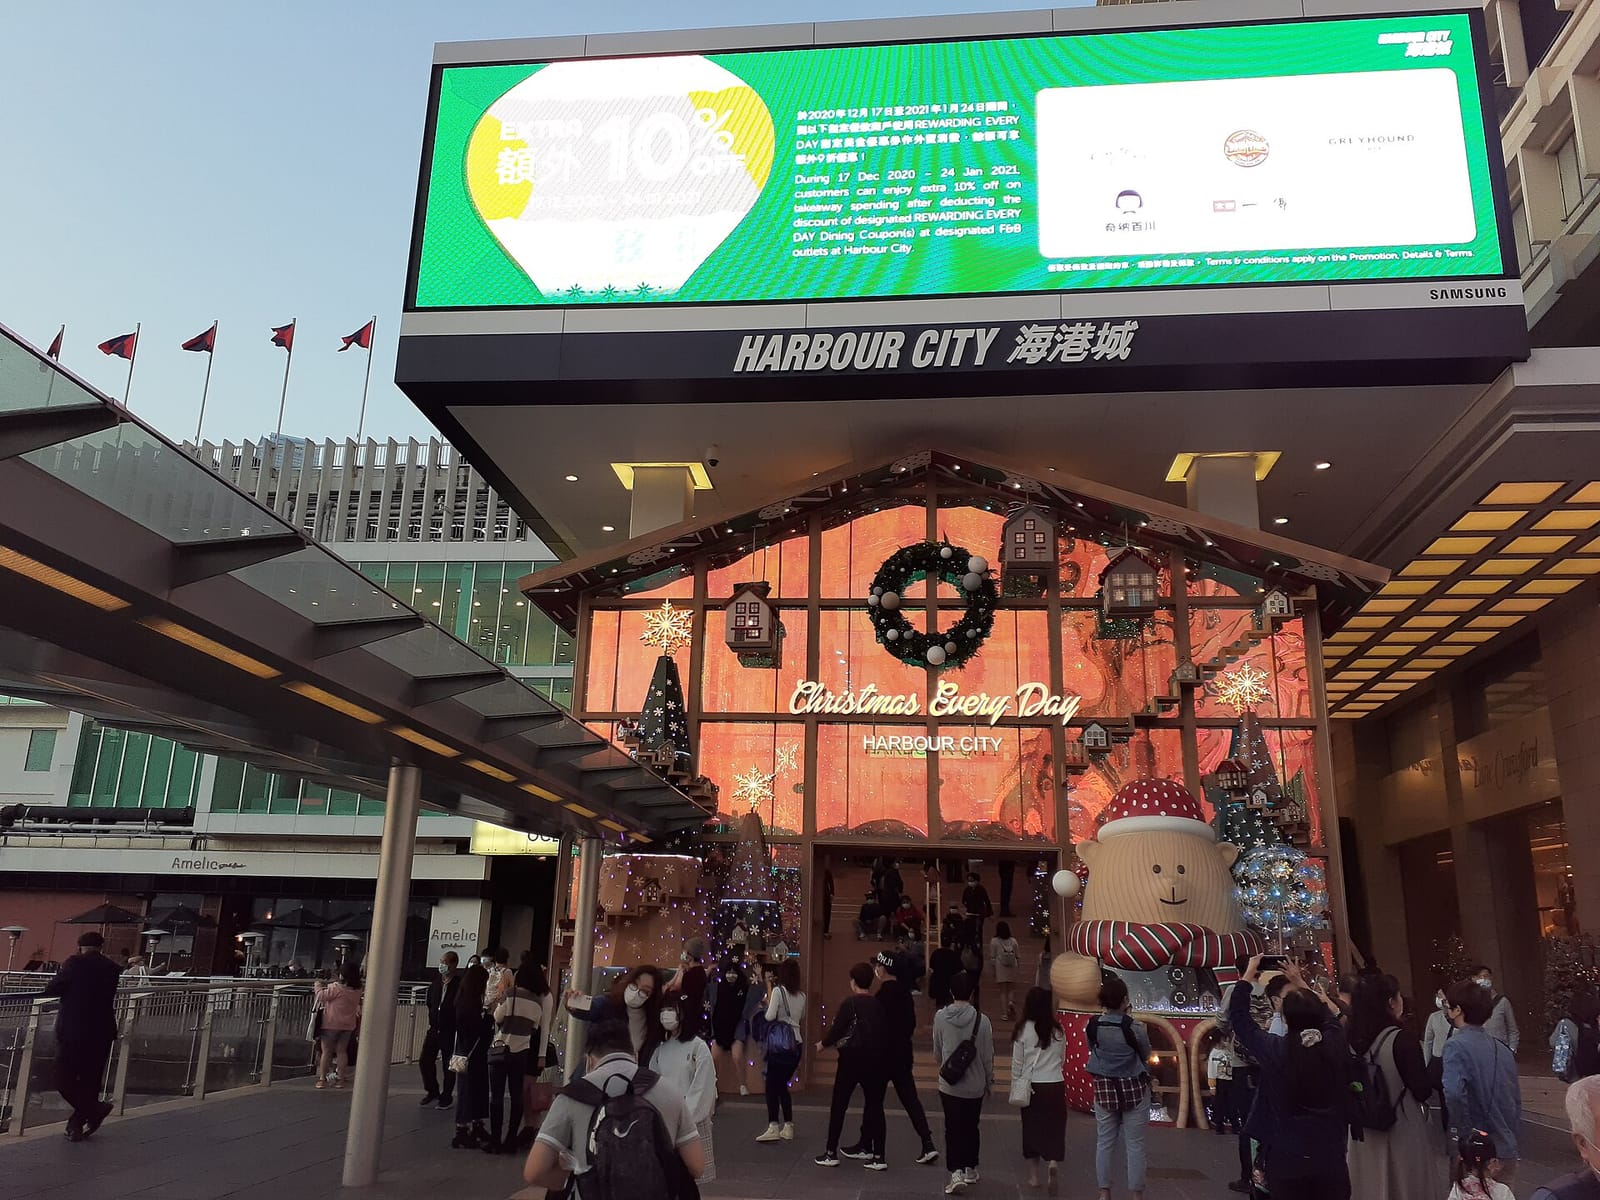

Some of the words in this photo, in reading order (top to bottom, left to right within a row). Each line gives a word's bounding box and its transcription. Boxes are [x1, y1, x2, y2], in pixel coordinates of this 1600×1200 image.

[915, 118, 982, 129] REWARDING
[985, 115, 1020, 126] EVERY
[796, 140, 819, 150] DAY
[795, 174, 830, 185] During
[838, 172, 851, 182] 17
[858, 171, 880, 182] Dec
[888, 169, 916, 181] 2020
[940, 167, 956, 178] 24
[963, 167, 984, 178] Jan
[794, 188, 850, 199] customers
[857, 186, 877, 196] can
[883, 184, 913, 196] enjoy
[920, 183, 947, 193] extra
[954, 181, 977, 192] 10%
[983, 180, 999, 190] off
[1006, 181, 1022, 189] on
[794, 202, 844, 214] takeaway
[850, 199, 900, 212] spending
[907, 198, 933, 208] after
[939, 196, 995, 208] deducting
[1003, 194, 1022, 204] the
[793, 217, 839, 228] discount
[840, 216, 853, 226] of
[854, 213, 912, 227] designated
[914, 210, 984, 223] REWARDING
[986, 208, 1022, 220] EVERY
[793, 231, 816, 243] DAY
[820, 230, 855, 243] Dining
[860, 227, 915, 241] Coupon(s)
[920, 227, 931, 237] at
[935, 224, 995, 238] designated
[792, 246, 829, 257] outlets
[831, 246, 842, 255] at
[843, 244, 889, 255] Harbour
[1205, 257, 1233, 266] Terms
[1243, 255, 1290, 265] conditions
[1292, 254, 1316, 264] apply
[1331, 253, 1348, 261] the
[1402, 250, 1434, 259] Details
[1430, 287, 1507, 300] SAMSUNG
[733, 331, 906, 373] HARBOUR
[912, 327, 1001, 369] CITY
[1006, 320, 1139, 365] 海港城
[789, 679, 920, 715] Christmas
[929, 680, 1012, 726] Every
[1016, 682, 1081, 726] Day
[863, 735, 955, 752] HARBOUR
[960, 736, 1003, 752] CITY
